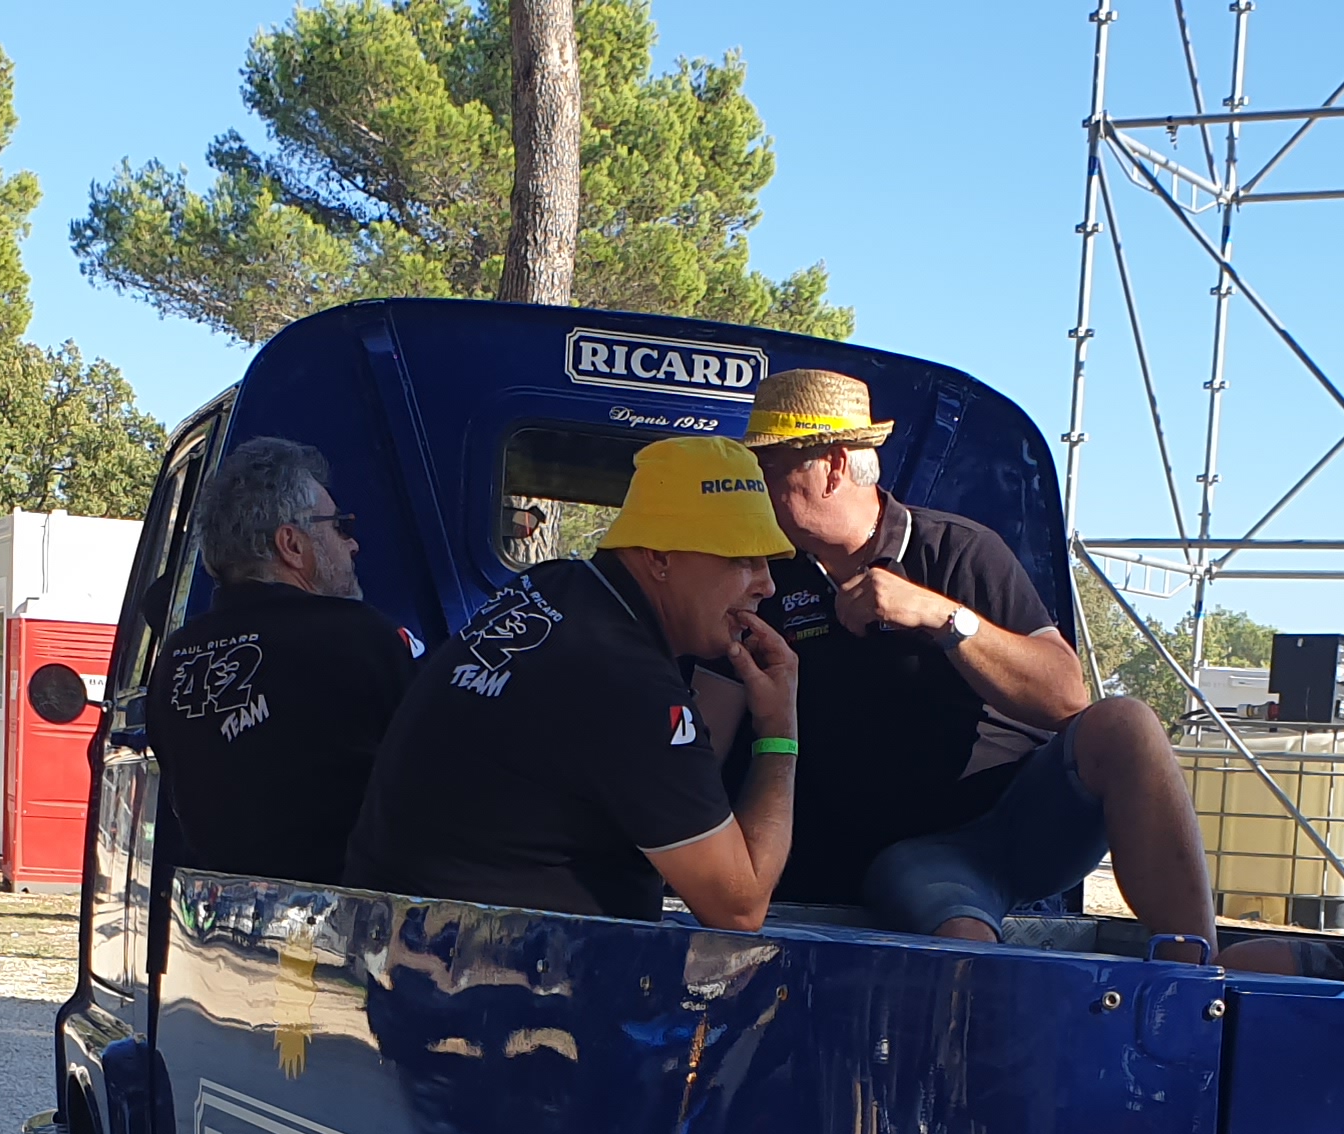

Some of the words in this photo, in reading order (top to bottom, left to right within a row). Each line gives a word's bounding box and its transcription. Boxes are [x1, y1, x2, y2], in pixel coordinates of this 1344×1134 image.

[578, 341, 754, 388] RICARD
[609, 405, 670, 427] Depuis
[795, 421, 830, 432] RICARD
[701, 478, 765, 495] RICARD
[529, 591, 564, 623] RICARD
[173, 645, 203, 658] PAUL
[207, 633, 260, 650] RICARD
[449, 664, 512, 697] TEAM
[220, 694, 270, 742] TEAM
